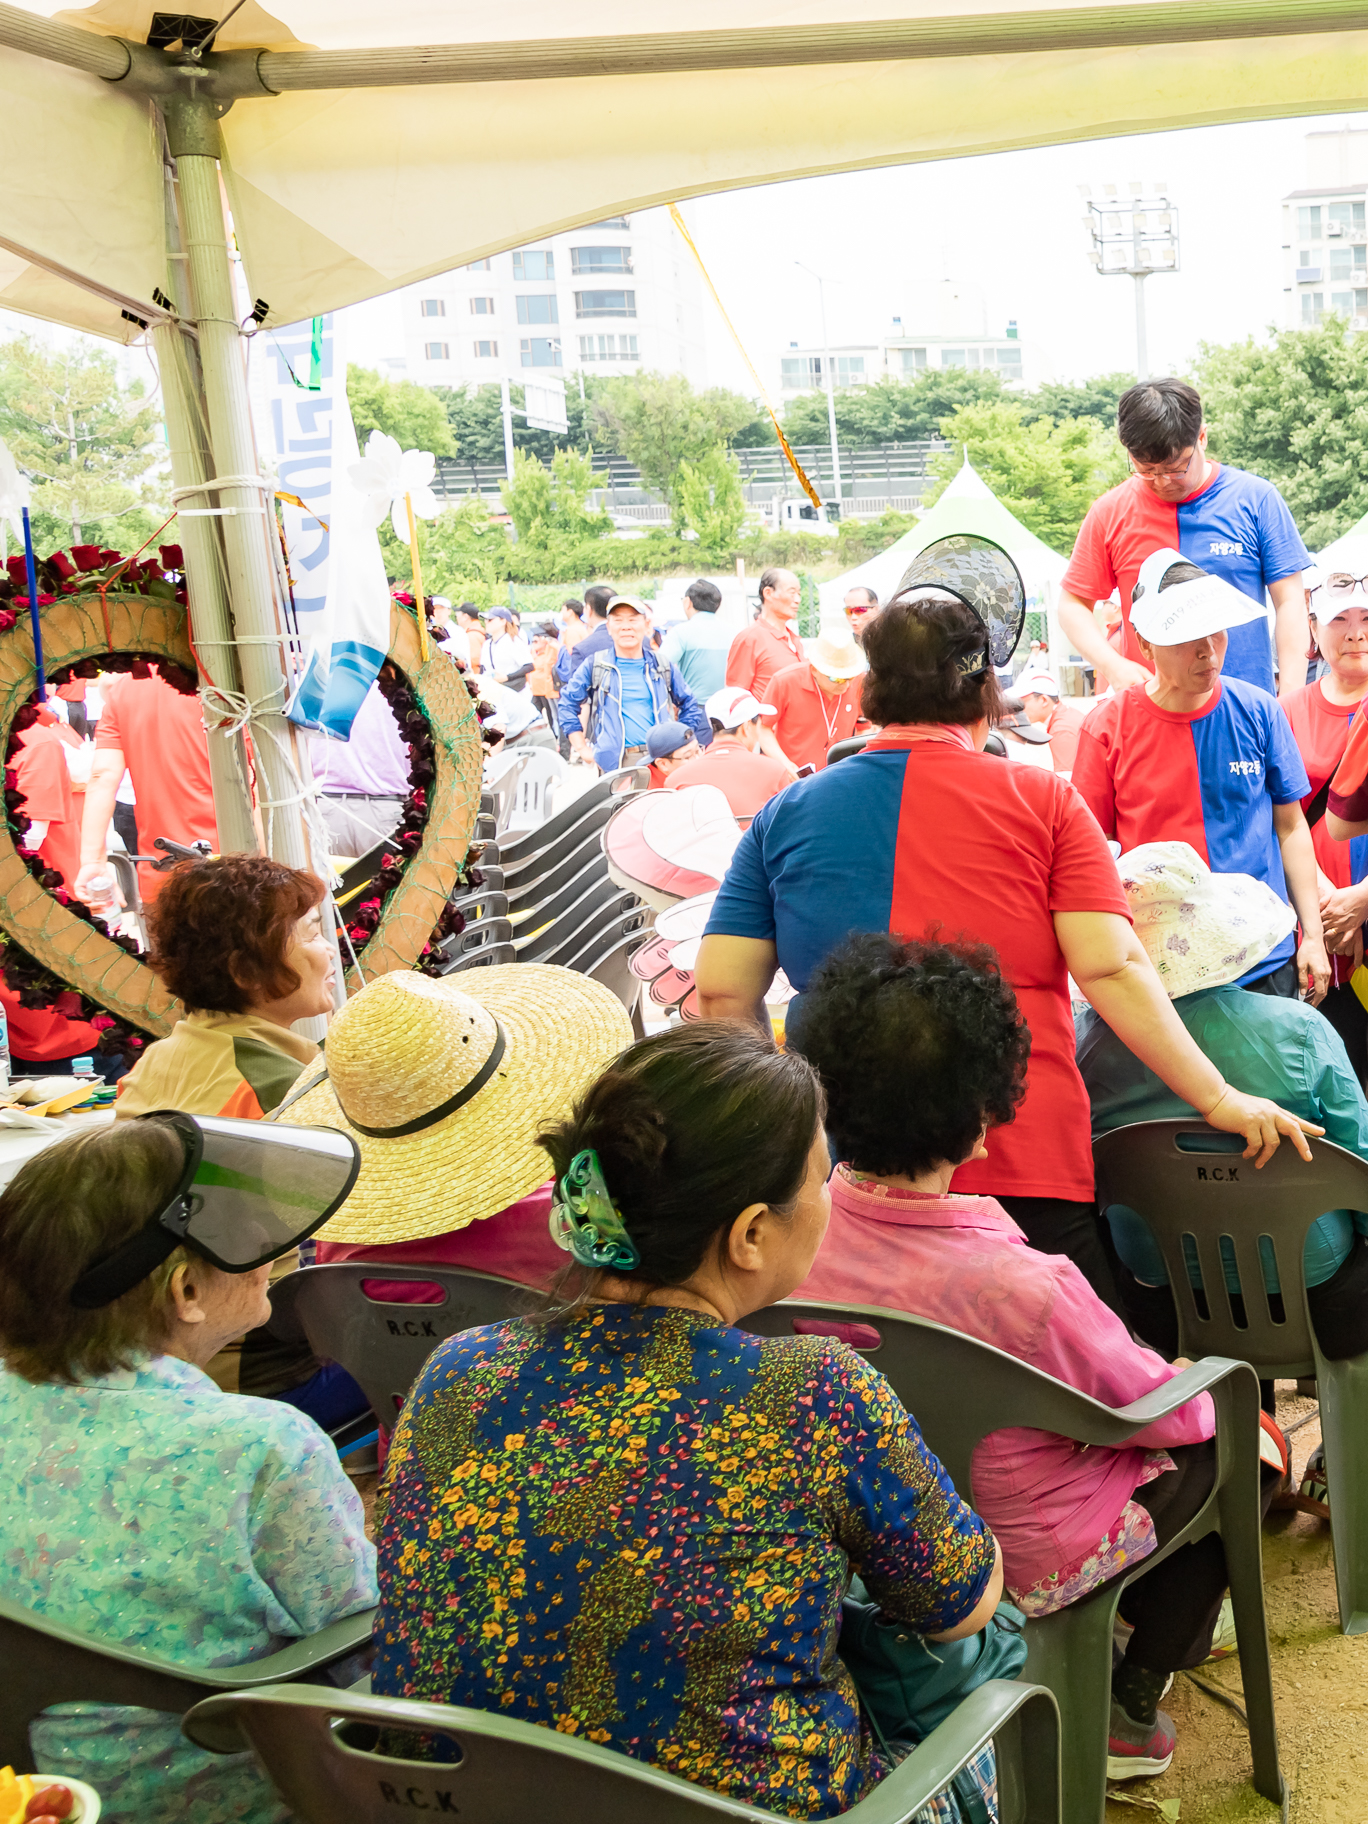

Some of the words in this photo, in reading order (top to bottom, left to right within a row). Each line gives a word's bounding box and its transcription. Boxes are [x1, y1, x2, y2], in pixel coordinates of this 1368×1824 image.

[1209, 541, 1244, 556] 자양2동
[1161, 607, 1185, 631] 2019
[1229, 760, 1261, 776] 자양2동
[1197, 1166, 1240, 1182] R.C.K
[386, 1318, 438, 1339] R.C.K
[379, 1780, 460, 1814] R.C.K
